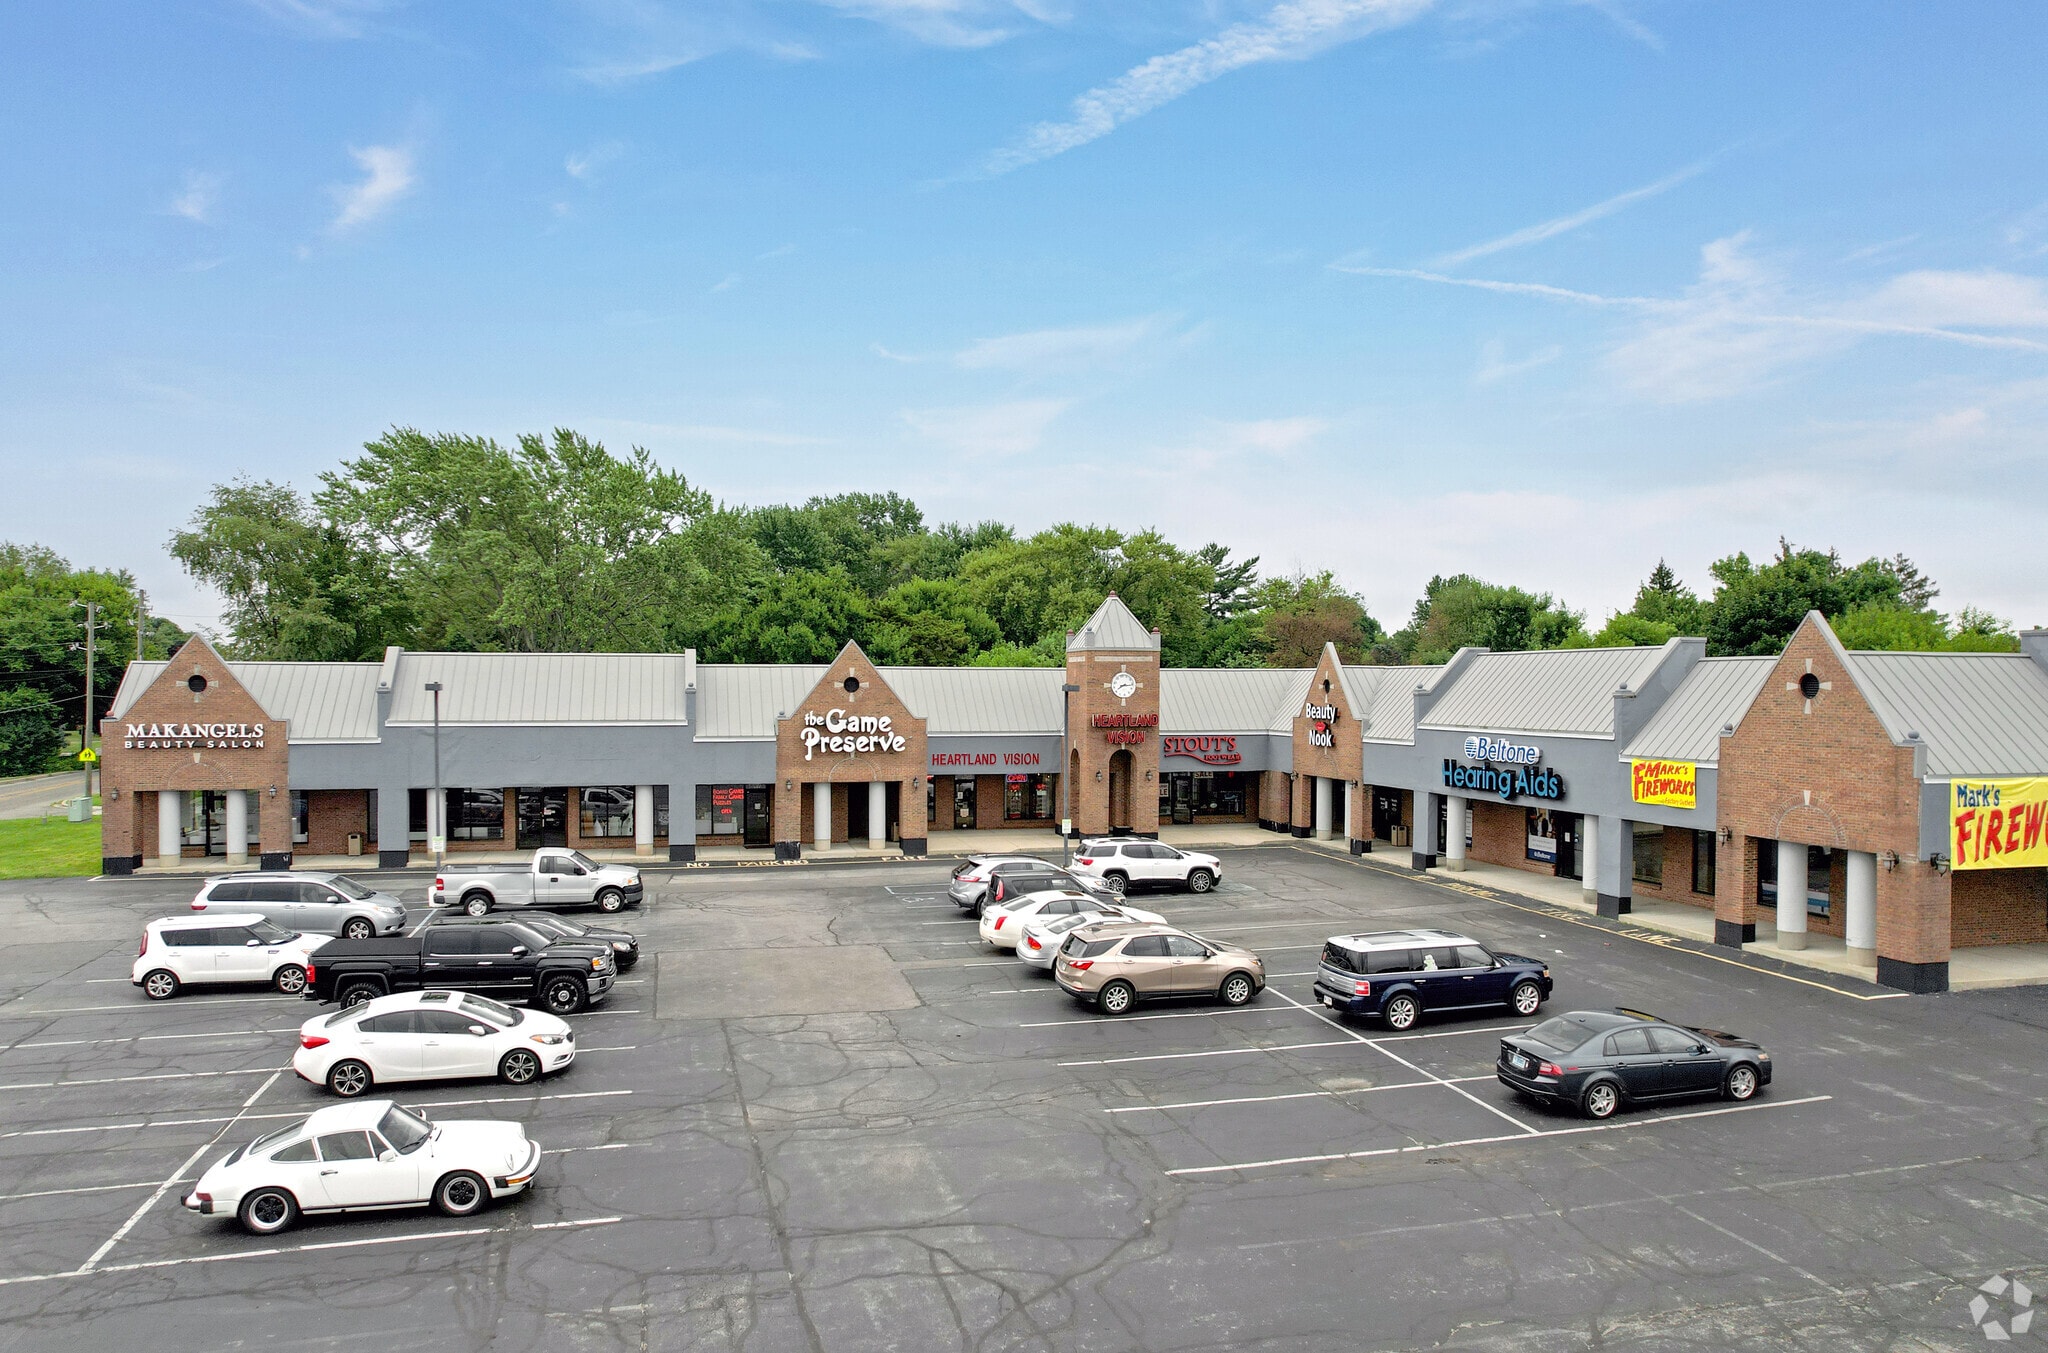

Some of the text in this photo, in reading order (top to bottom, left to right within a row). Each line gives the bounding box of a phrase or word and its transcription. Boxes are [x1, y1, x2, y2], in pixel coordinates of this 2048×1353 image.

[804, 708, 892, 734] the Game
[1091, 713, 1159, 727] HEARTLAND
[1306, 702, 1336, 724] Beauty
[124, 723, 264, 738] MAKANGELS
[1106, 730, 1146, 743] VISION
[1309, 729, 1332, 747] Nook
[124, 740, 265, 749] BEAUTY SALON
[800, 727, 906, 761] Preserve
[1164, 736, 1238, 752] STOUT'S
[1477, 737, 1537, 764] Beltone
[932, 753, 1040, 766] HEARTLAND VISION
[1204, 753, 1242, 762] FOOTWEAR
[1441, 760, 1559, 799] Hearing Aids
[1633, 762, 1695, 801] FIREWORKS
[1956, 783, 2001, 808] Mark's
[1955, 799, 2048, 866] FIREW
